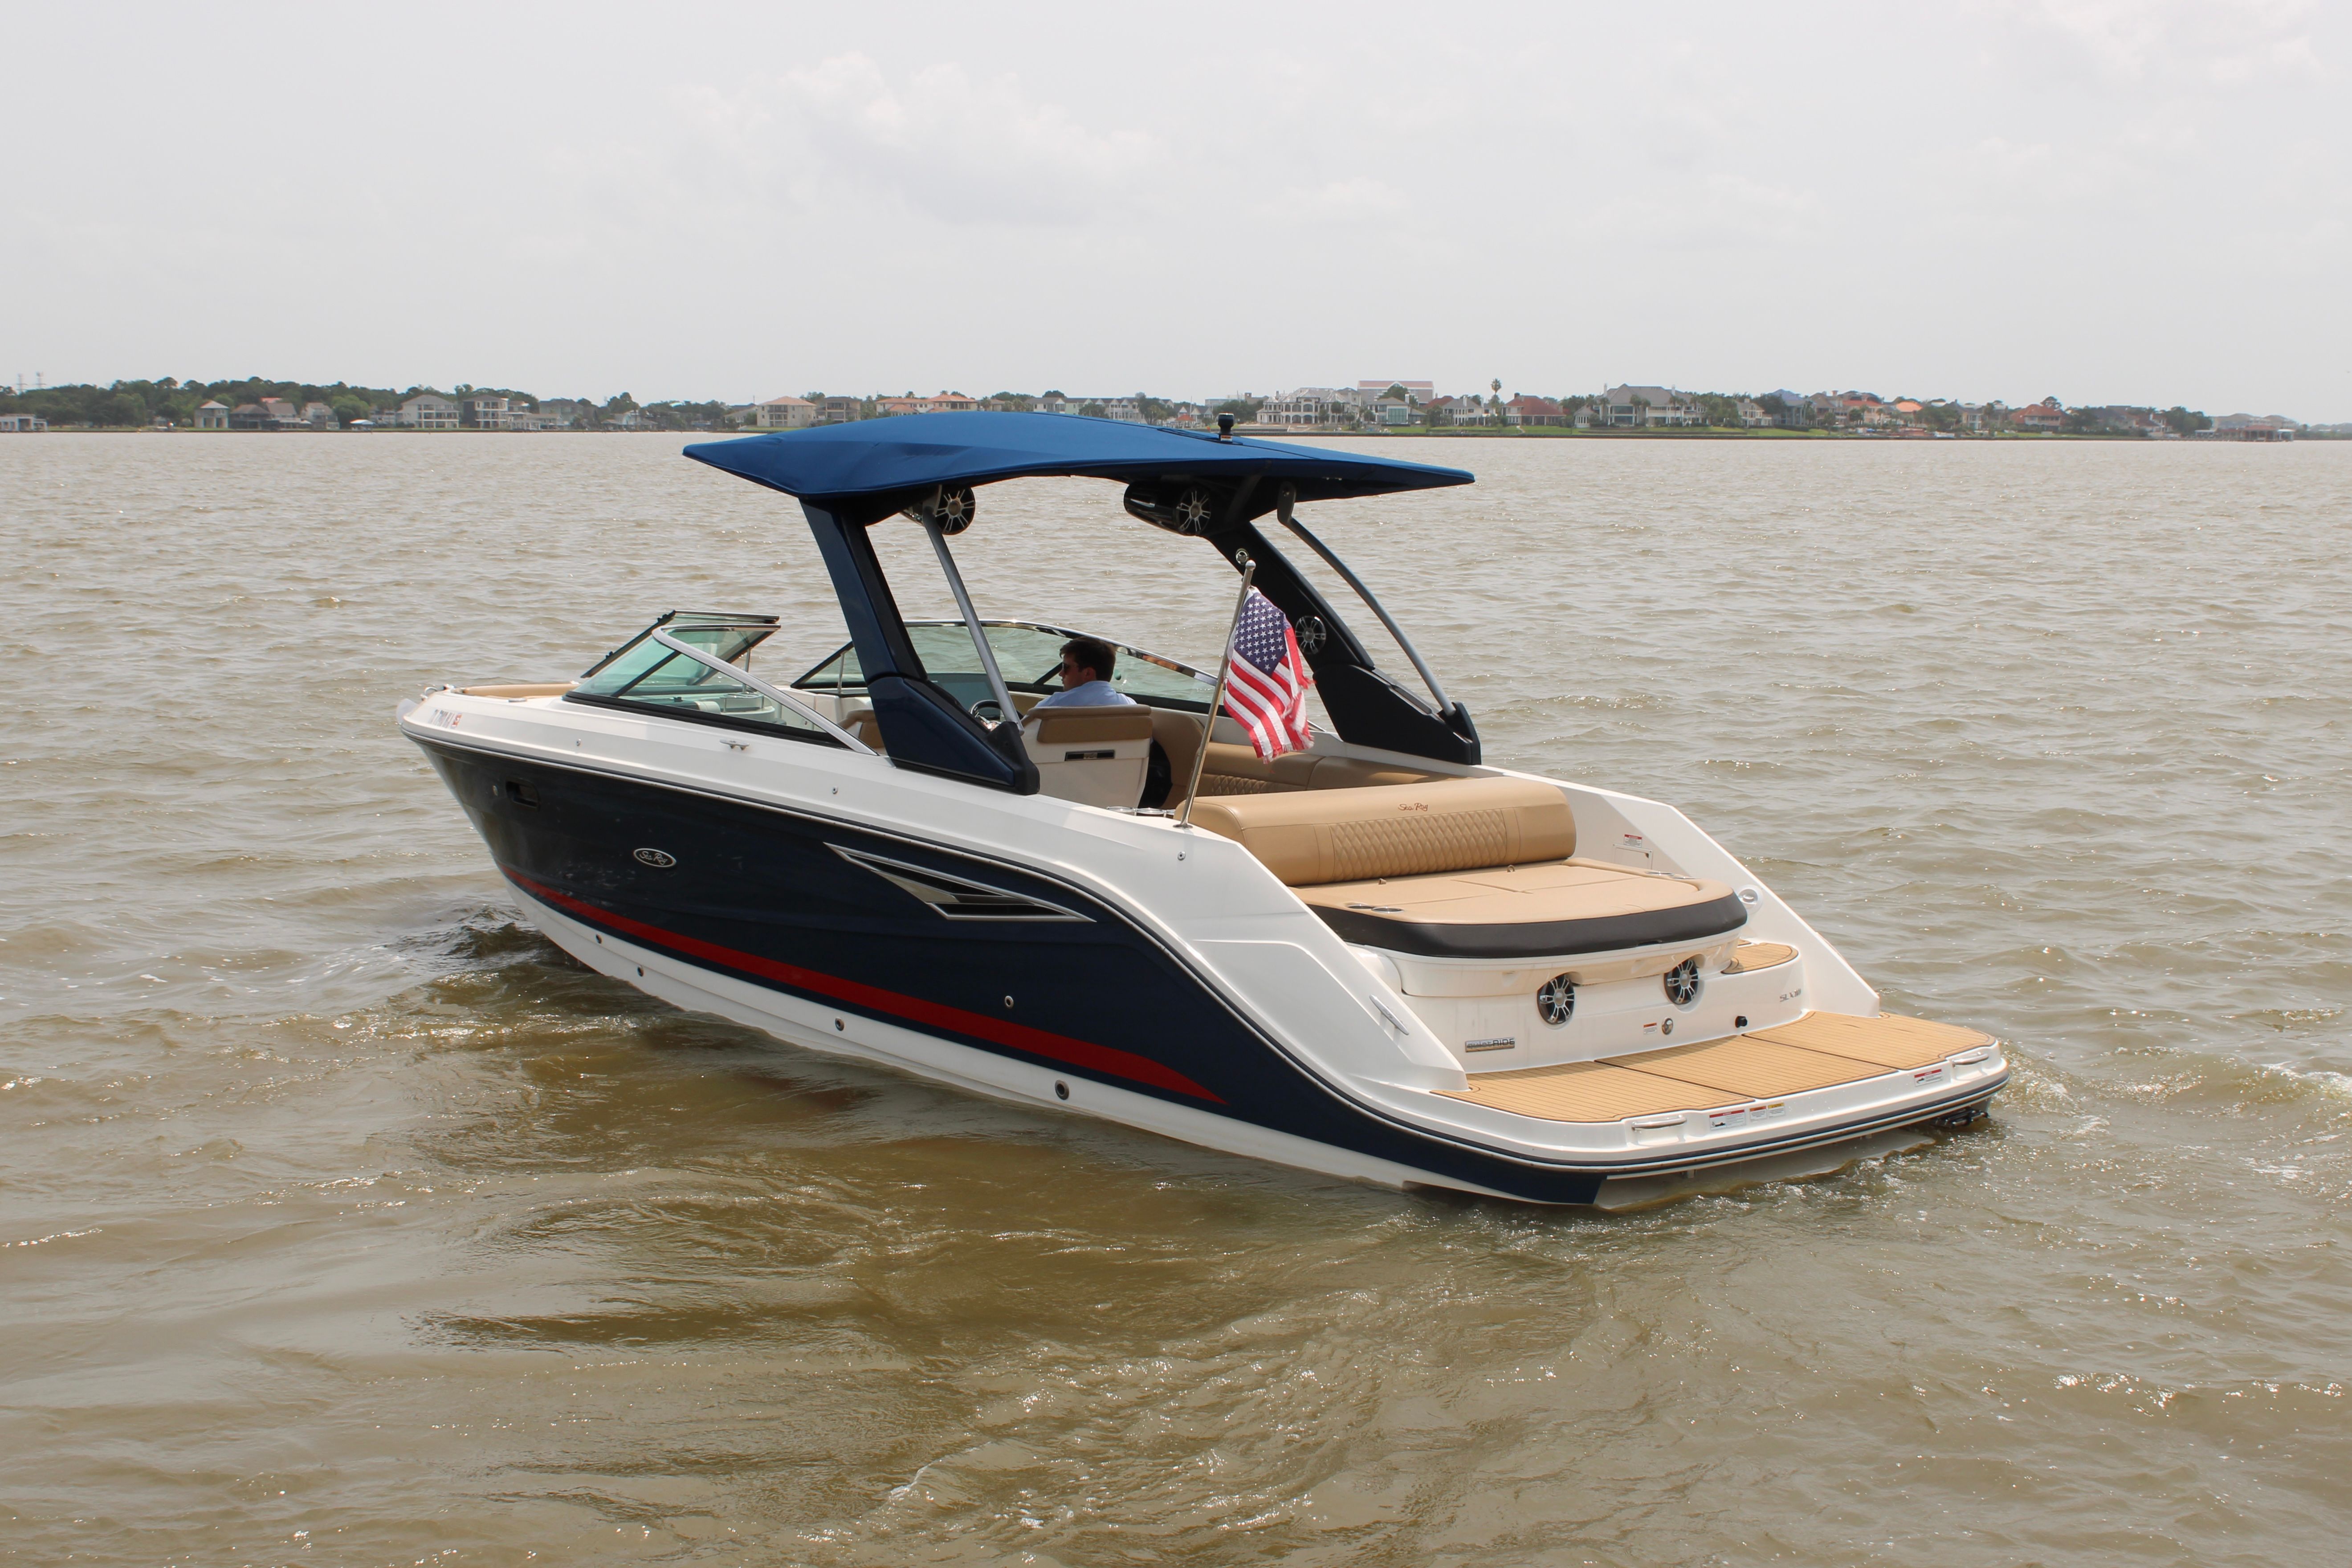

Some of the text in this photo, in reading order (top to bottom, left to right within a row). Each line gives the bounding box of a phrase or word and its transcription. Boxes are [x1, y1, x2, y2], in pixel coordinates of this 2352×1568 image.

[1414, 802, 1428, 812] Ray
[639, 851, 668, 865] Sea Ray
